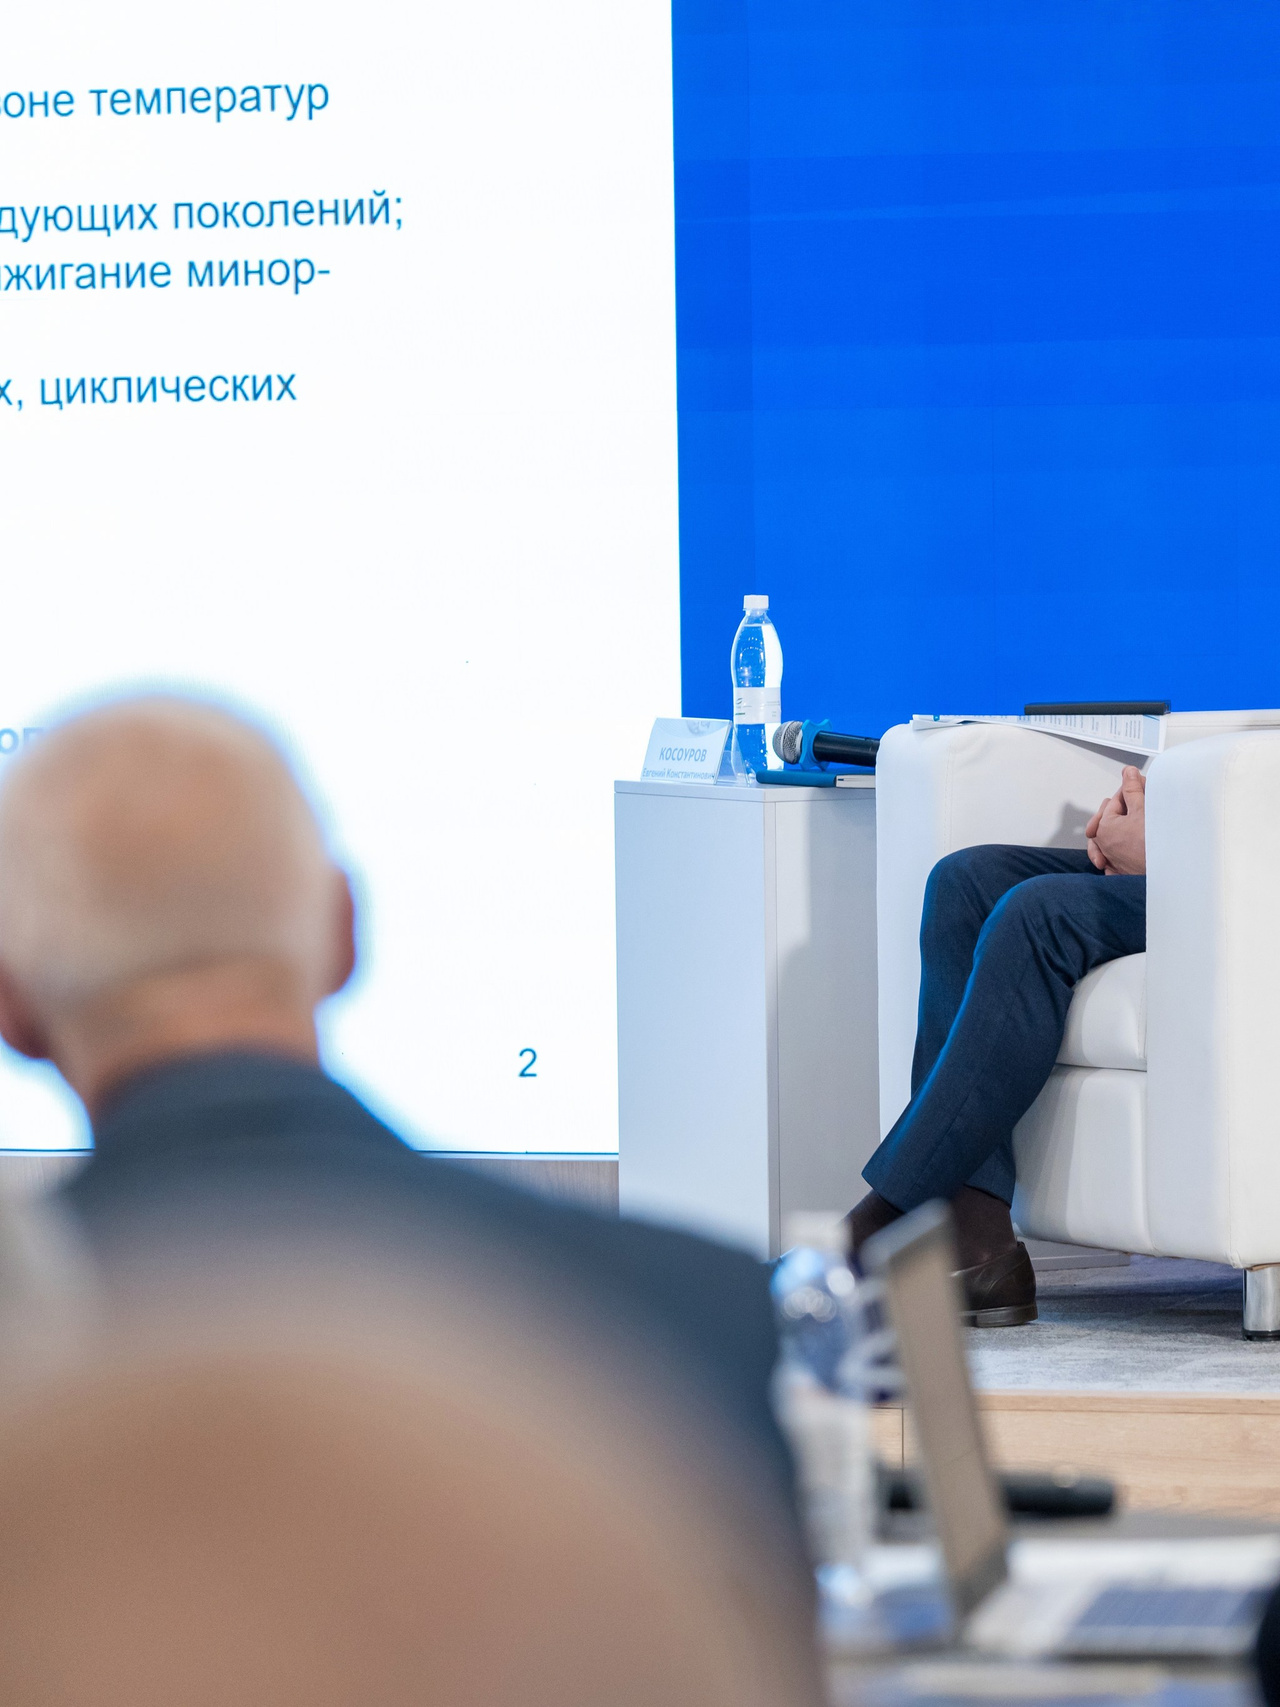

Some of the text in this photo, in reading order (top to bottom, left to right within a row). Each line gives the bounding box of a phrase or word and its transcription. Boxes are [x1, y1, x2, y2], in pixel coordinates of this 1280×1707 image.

[0, 82, 330, 123] оне температур
[0, 189, 403, 242] дующих поколений;
[0, 257, 331, 295] жигание минор-
[41, 373, 297, 411] циклических
[658, 747, 708, 762] КОСОУРОВ
[518, 1048, 538, 1077] 2
